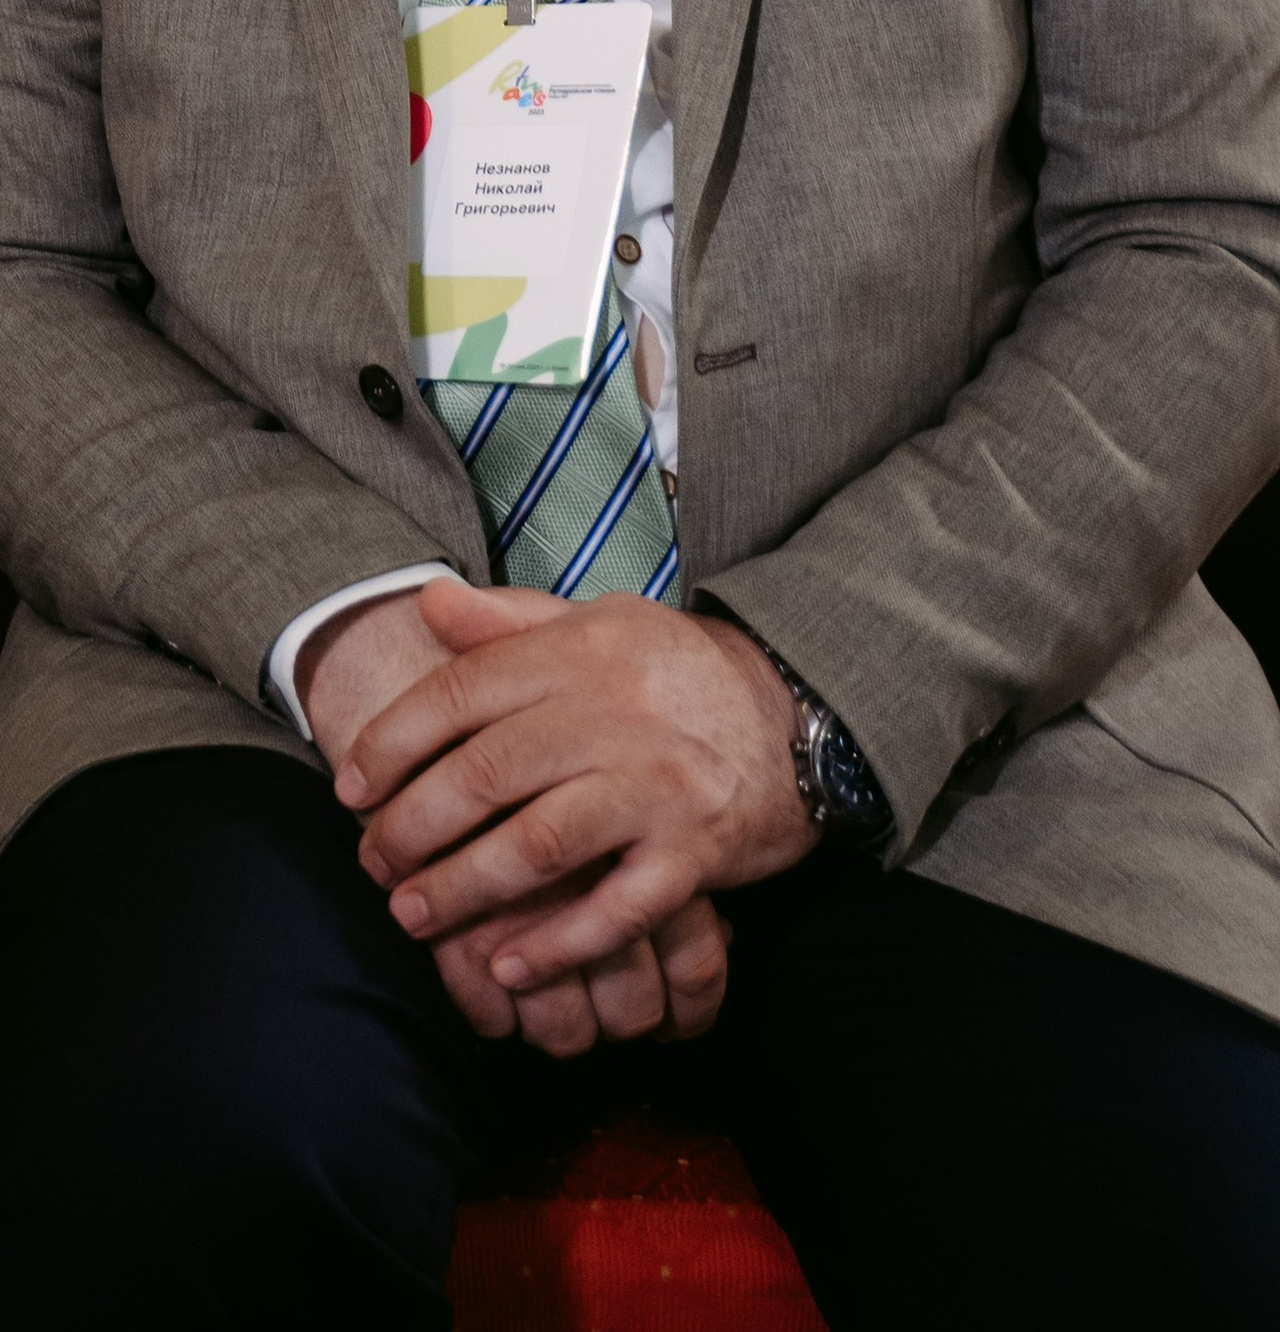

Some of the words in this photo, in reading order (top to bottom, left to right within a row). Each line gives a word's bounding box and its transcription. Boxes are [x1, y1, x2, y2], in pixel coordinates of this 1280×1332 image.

[475, 162, 550, 175] Незнанов
[475, 180, 543, 195] Николай
[455, 202, 556, 217] Григорьевич
